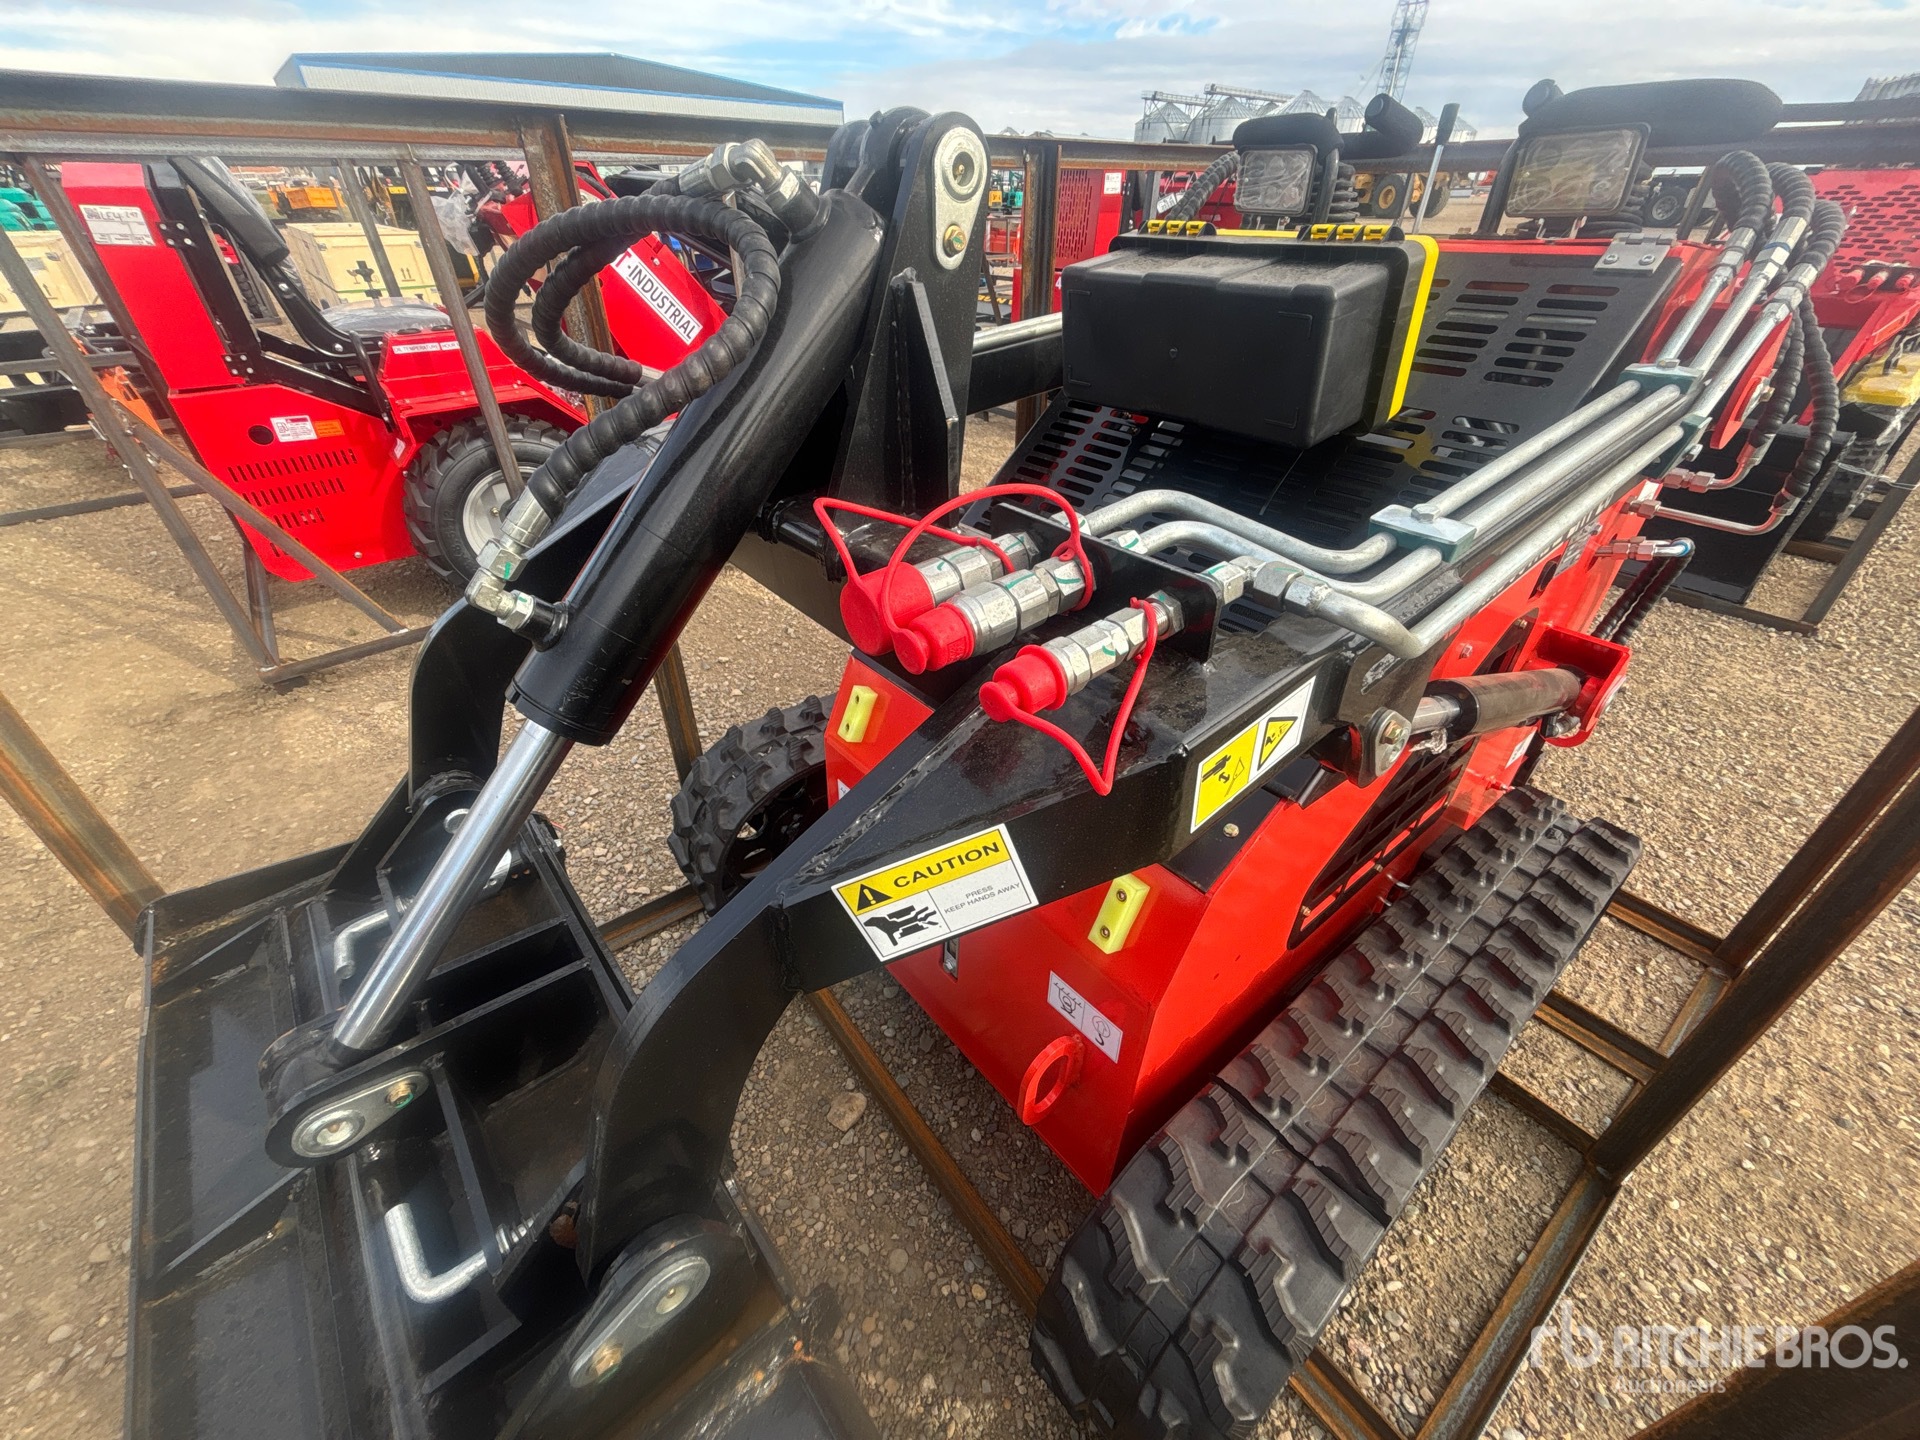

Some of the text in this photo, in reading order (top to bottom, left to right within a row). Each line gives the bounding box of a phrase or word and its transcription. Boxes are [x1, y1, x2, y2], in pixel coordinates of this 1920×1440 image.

[893, 841, 1000, 888] CAUTION
[943, 882, 1020, 914] KEEP HANDS AWAY
[965, 885, 994, 899] PRESS
